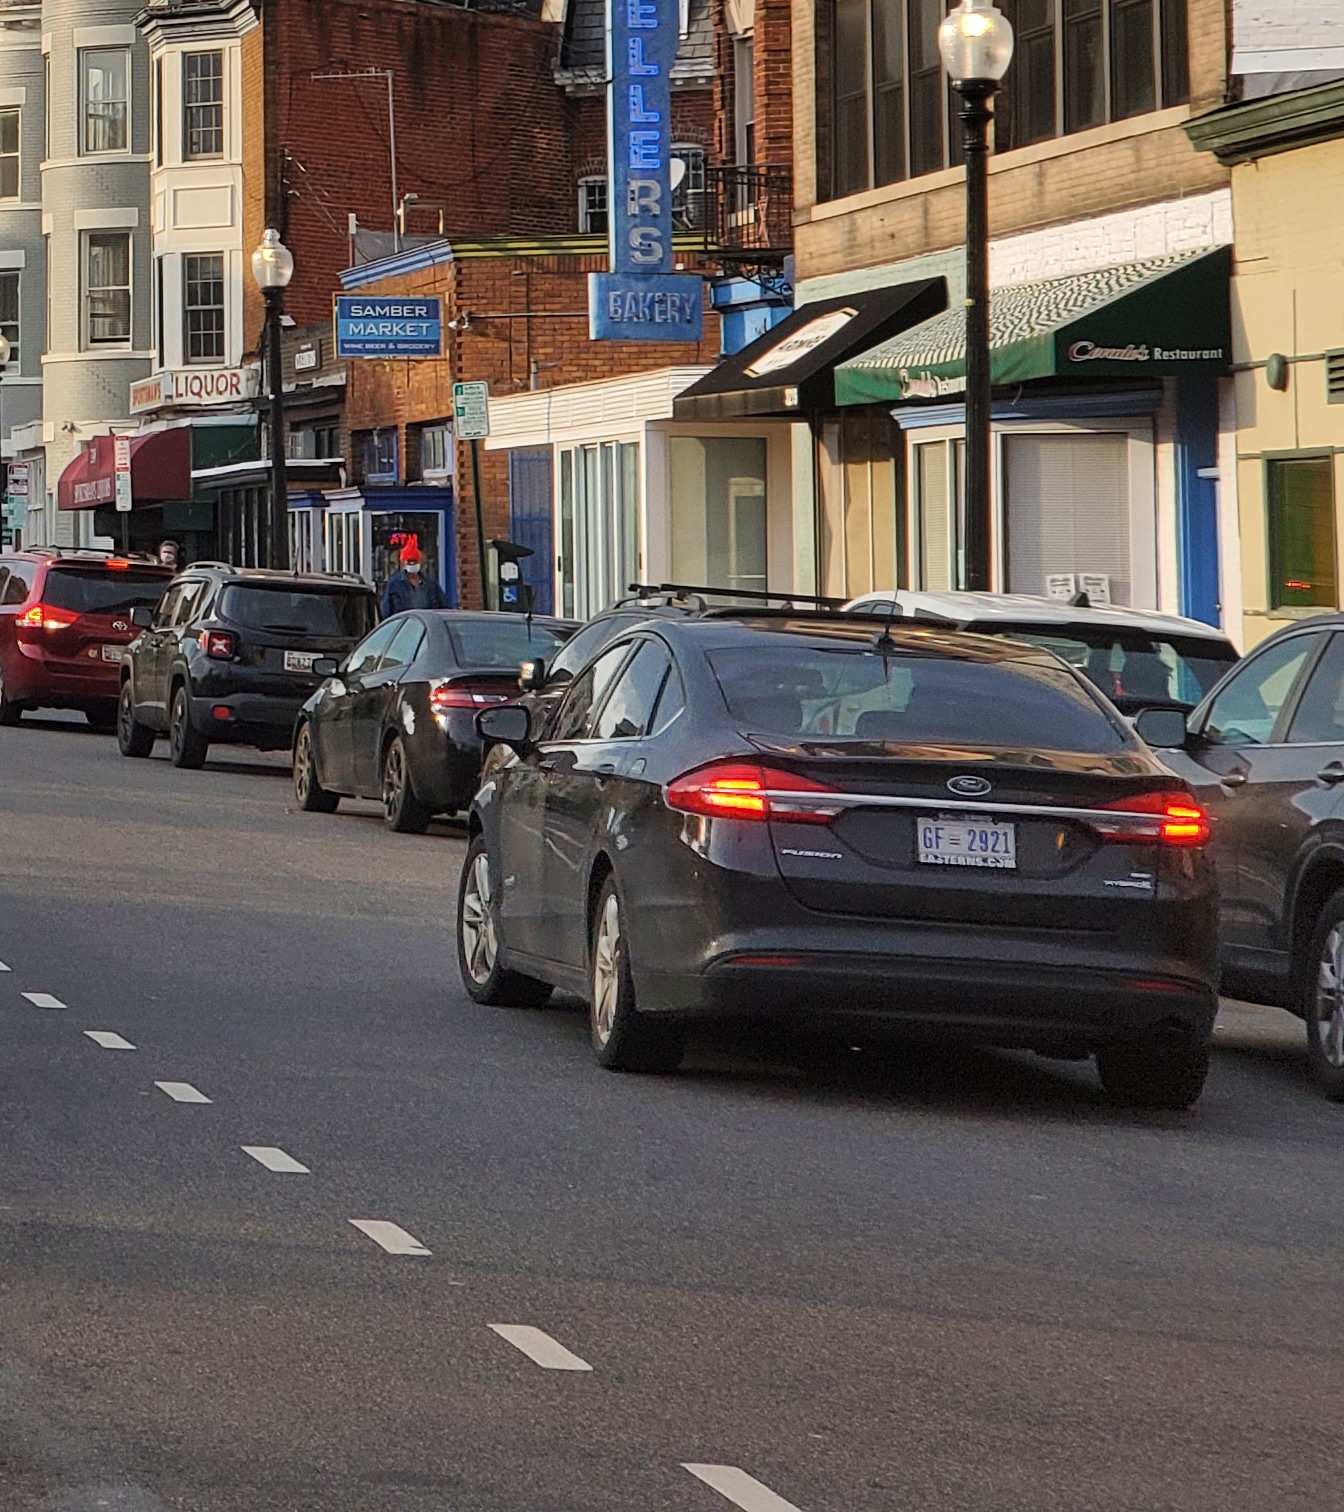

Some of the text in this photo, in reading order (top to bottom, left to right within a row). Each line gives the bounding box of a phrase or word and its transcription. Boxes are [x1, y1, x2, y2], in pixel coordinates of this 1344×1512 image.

[350, 305, 428, 317] SAMBER
[608, 289, 697, 324] BAKERY
[349, 322, 432, 336] MARKET
[1154, 347, 1223, 361] Restaurant
[174, 372, 242, 399] LIQUOR
[923, 826, 1011, 854] GF 2921
[781, 848, 843, 860] FUSION
[920, 853, 1016, 868] EASTERNS.COM
